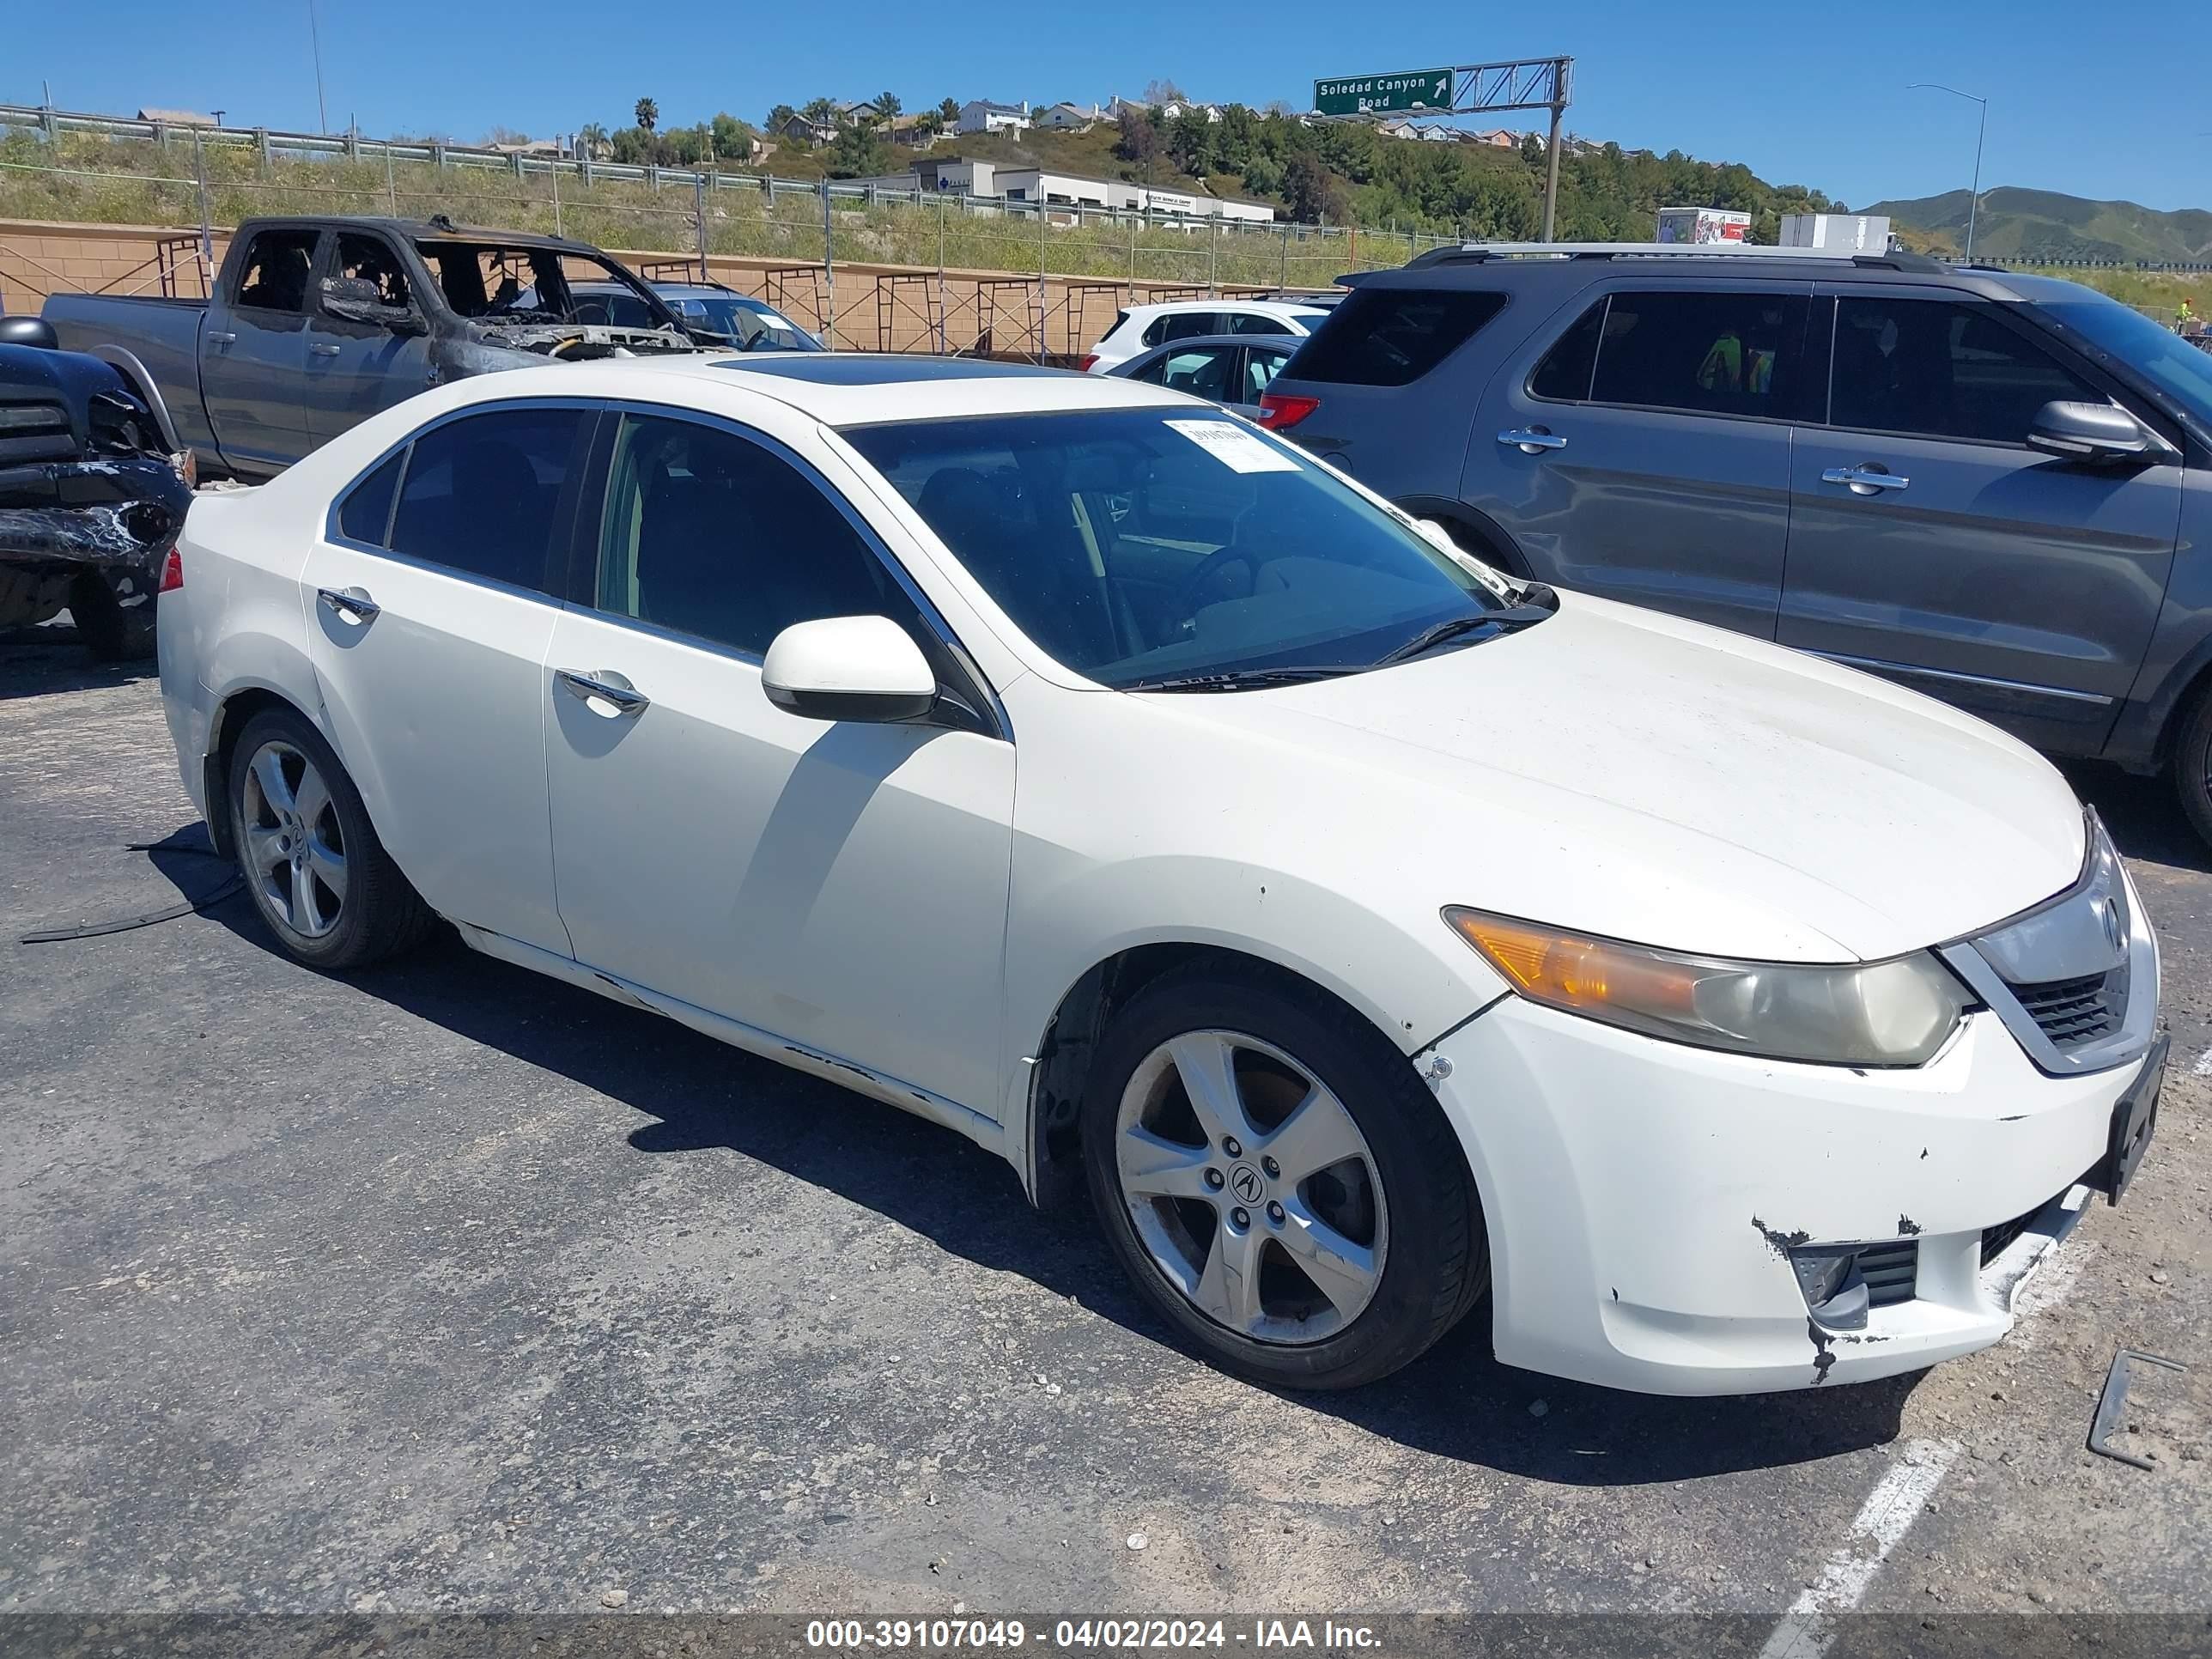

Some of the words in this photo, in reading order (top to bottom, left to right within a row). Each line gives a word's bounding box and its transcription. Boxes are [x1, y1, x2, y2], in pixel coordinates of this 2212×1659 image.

[1320, 81, 1371, 95] Soledad
[1377, 78, 1425, 93] Canyon
[1358, 95, 1389, 108] Road
